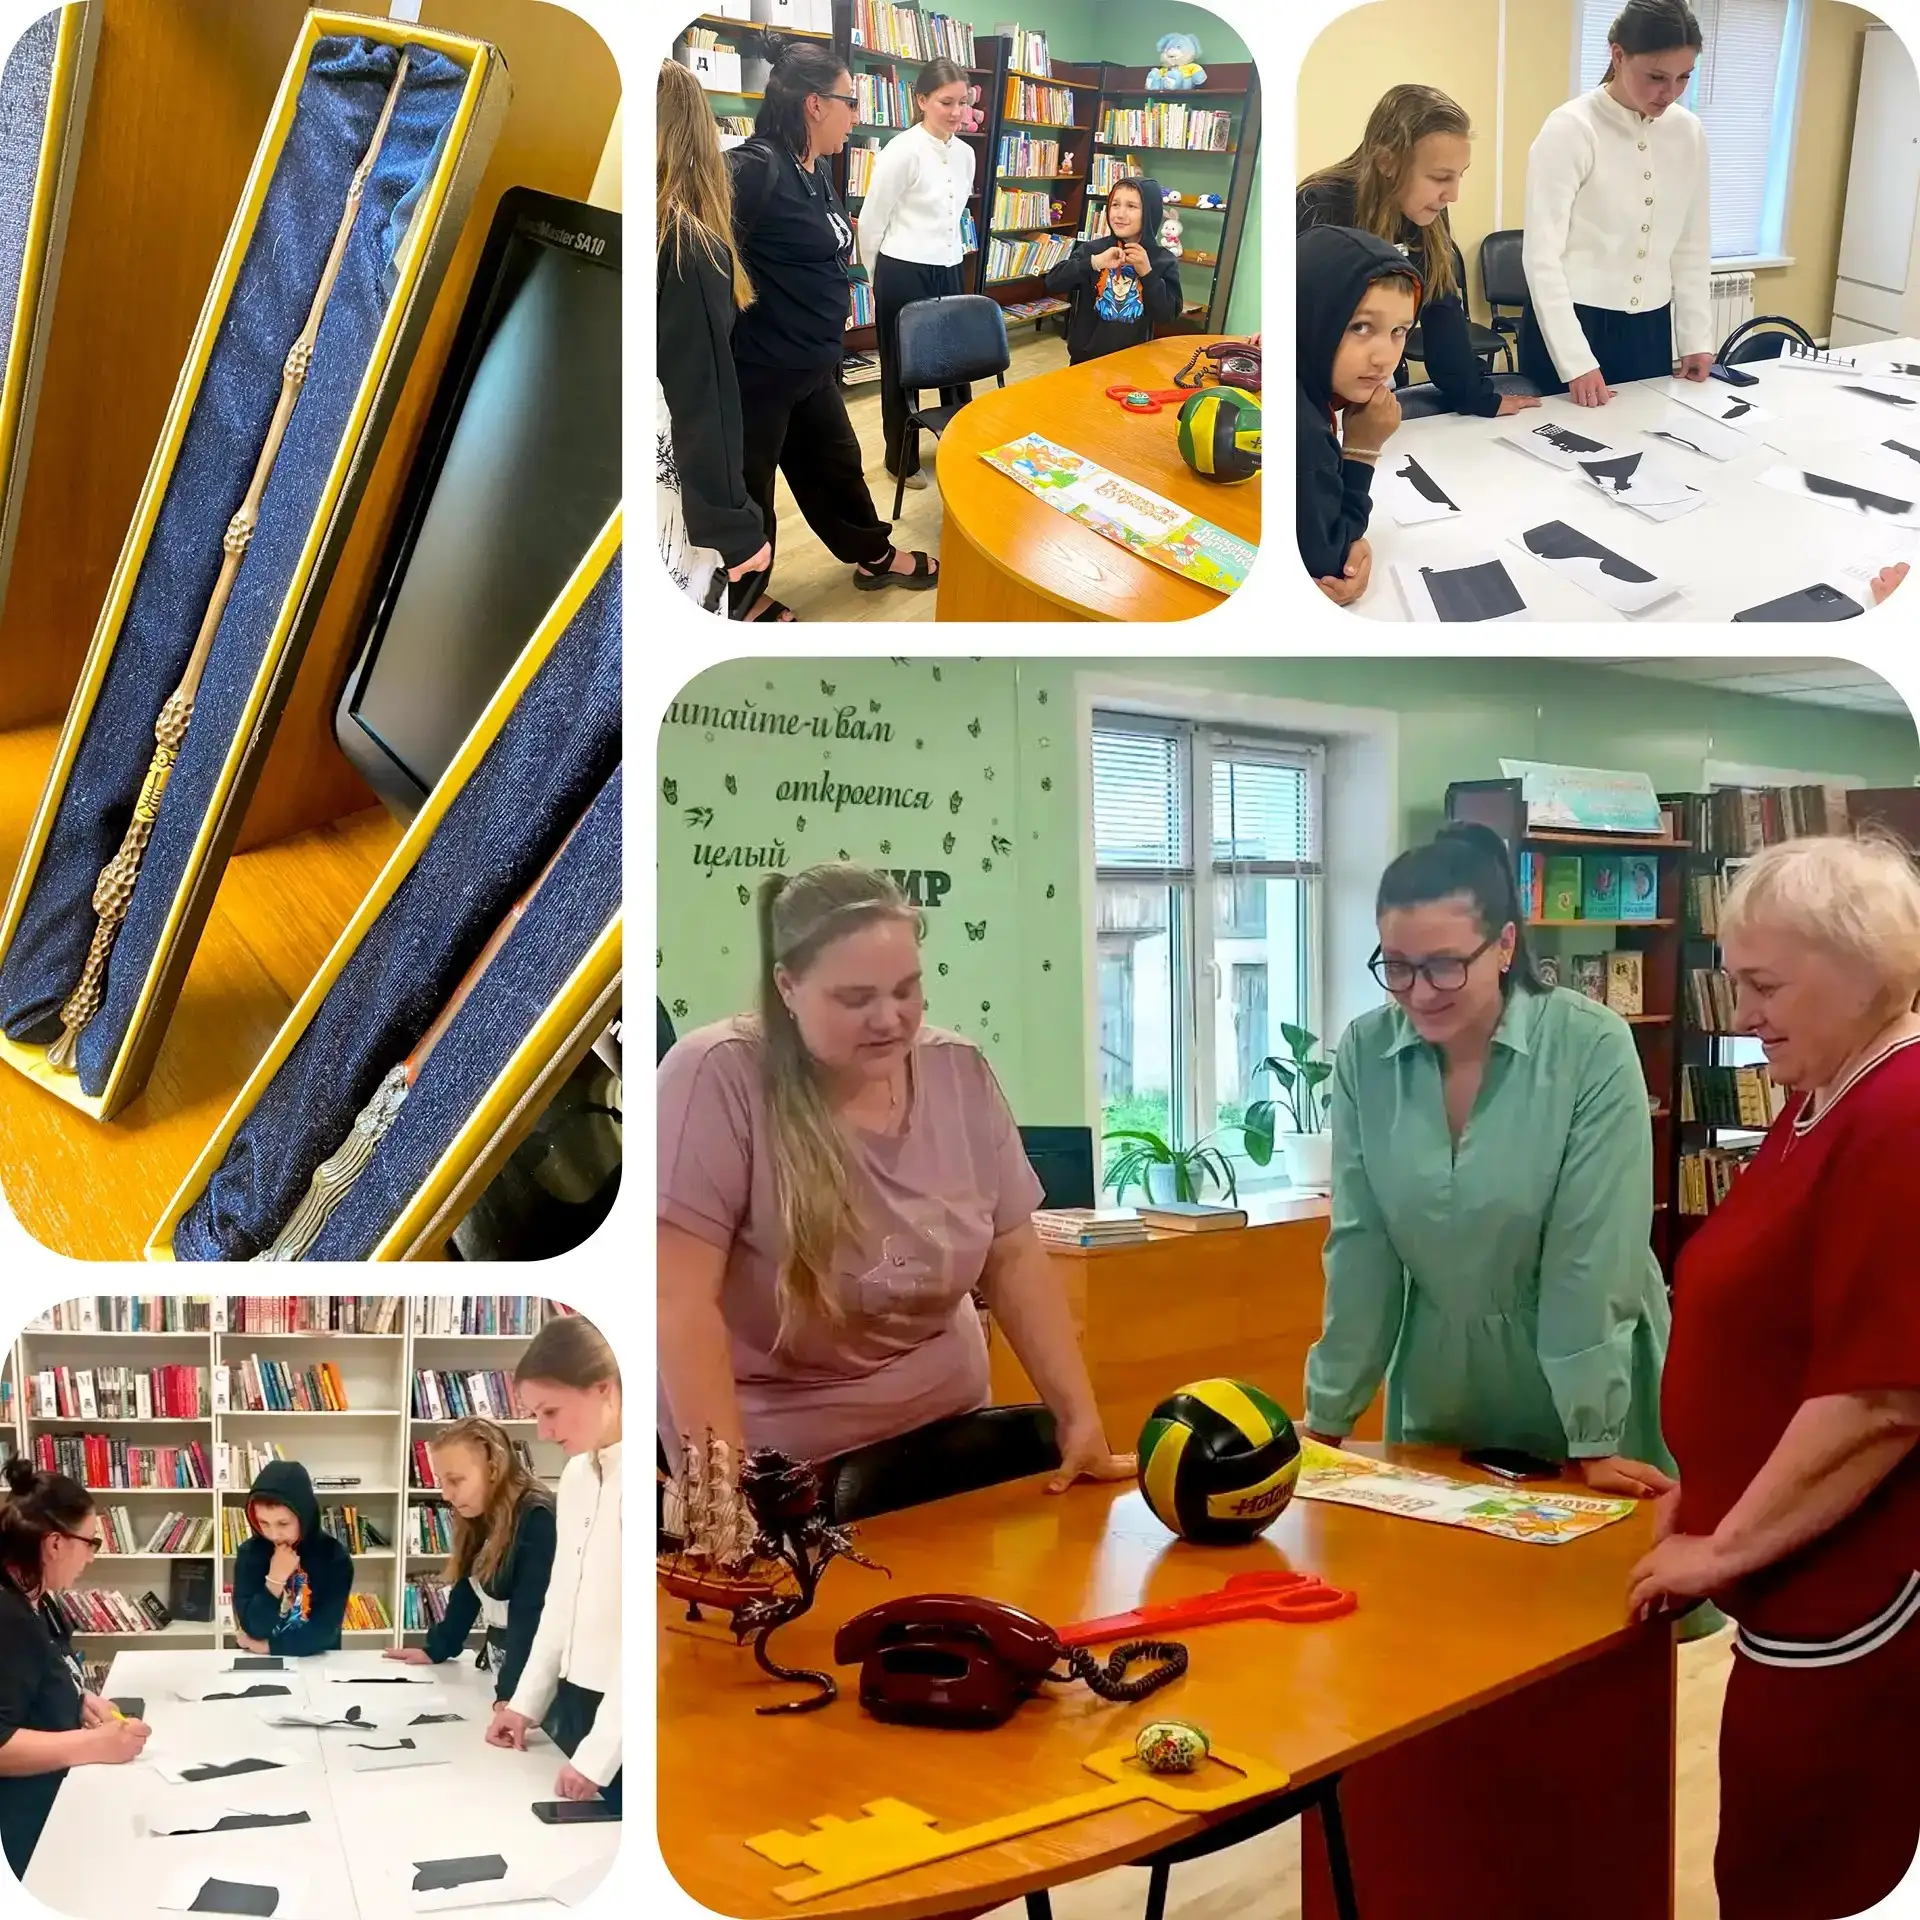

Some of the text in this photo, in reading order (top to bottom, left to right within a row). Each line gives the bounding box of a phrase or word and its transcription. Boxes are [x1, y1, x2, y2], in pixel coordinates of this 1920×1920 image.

[697, 56, 709, 71] Д
[574, 232, 606, 256] SA10
[776, 770, 935, 813] откроется
[693, 838, 790, 878] целый
[876, 870, 952, 907] ИР
[78, 1375, 91, 1387] М
